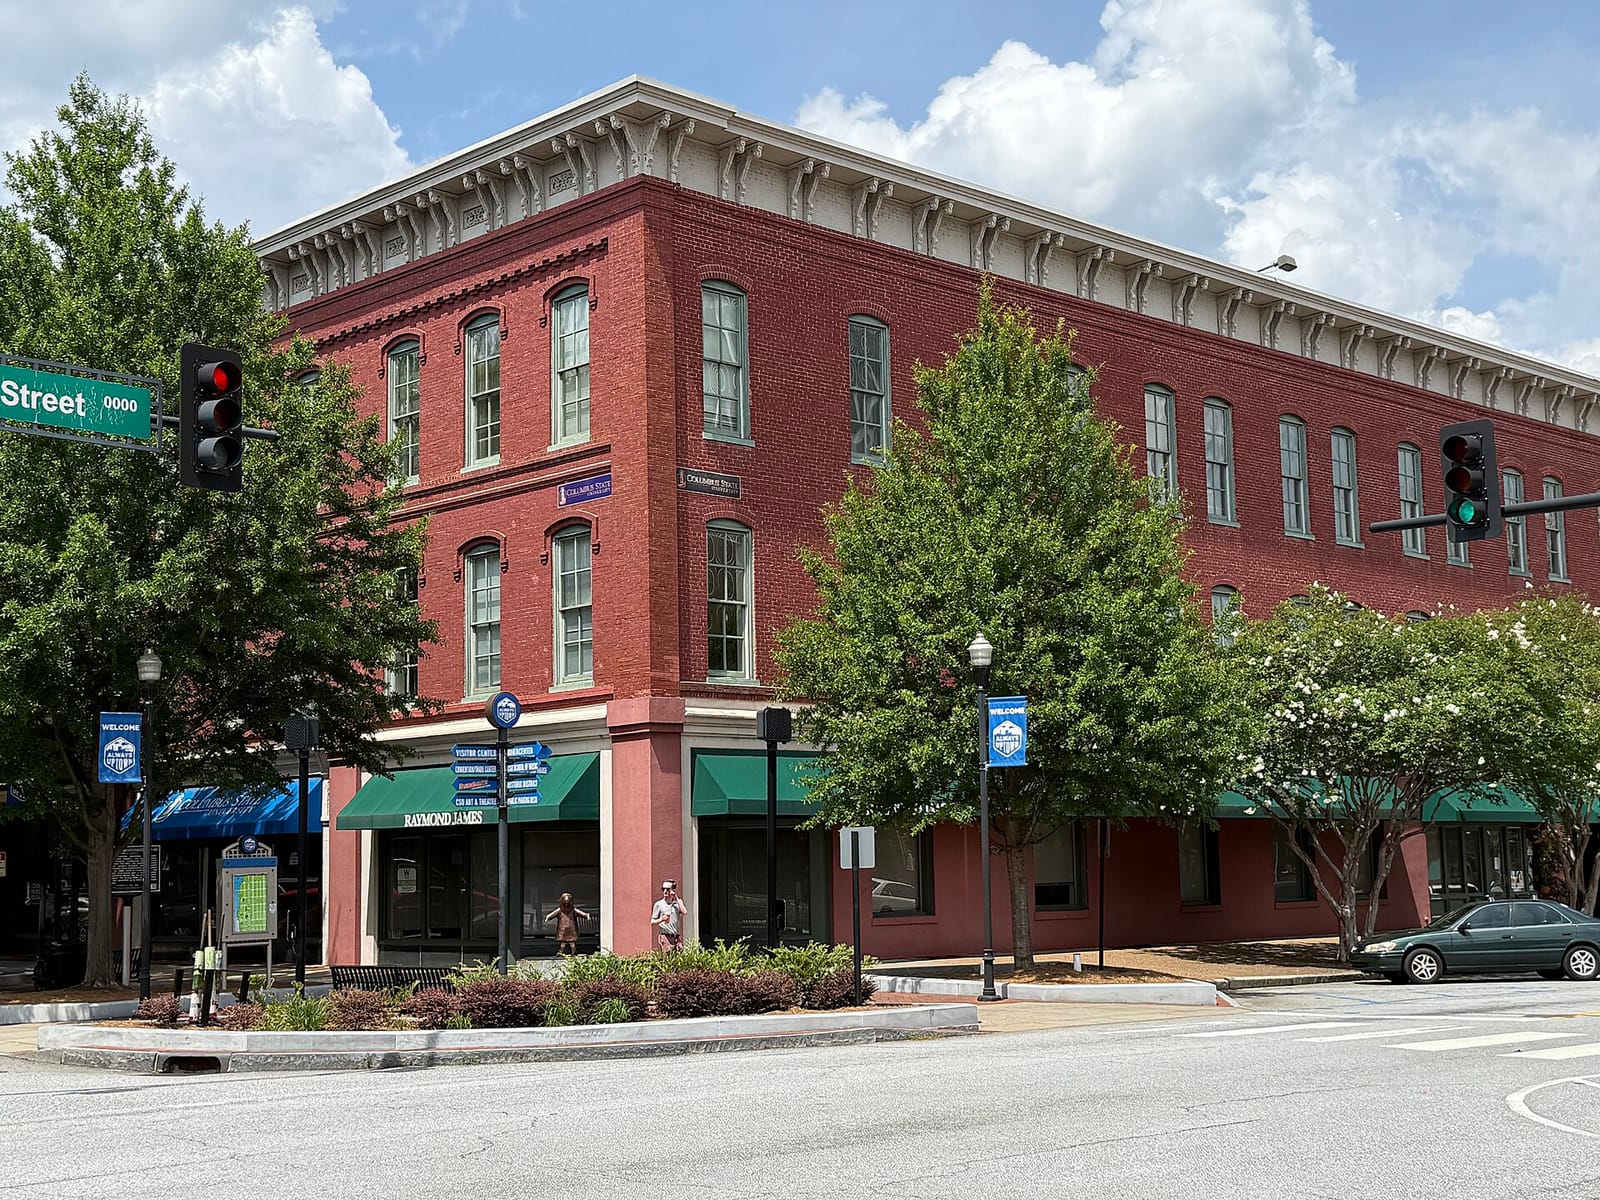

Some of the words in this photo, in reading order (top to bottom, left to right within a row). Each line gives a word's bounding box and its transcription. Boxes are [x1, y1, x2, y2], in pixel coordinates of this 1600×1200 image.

[1, 380, 86, 416] Street
[103, 395, 138, 412] 0000
[566, 484, 595, 496] COLUMBUS
[595, 480, 611, 490] STATE
[686, 474, 720, 486] COLUMBUS
[721, 480, 739, 490] STATE
[990, 707, 1025, 715] WELCOME
[456, 749, 476, 757] VISITOR
[477, 749, 497, 757] CENTER
[106, 758, 133, 770] UPTOWN
[465, 798, 474, 806] ART
[404, 812, 452, 827] RAYMOND
[452, 810, 483, 825] JAMES
